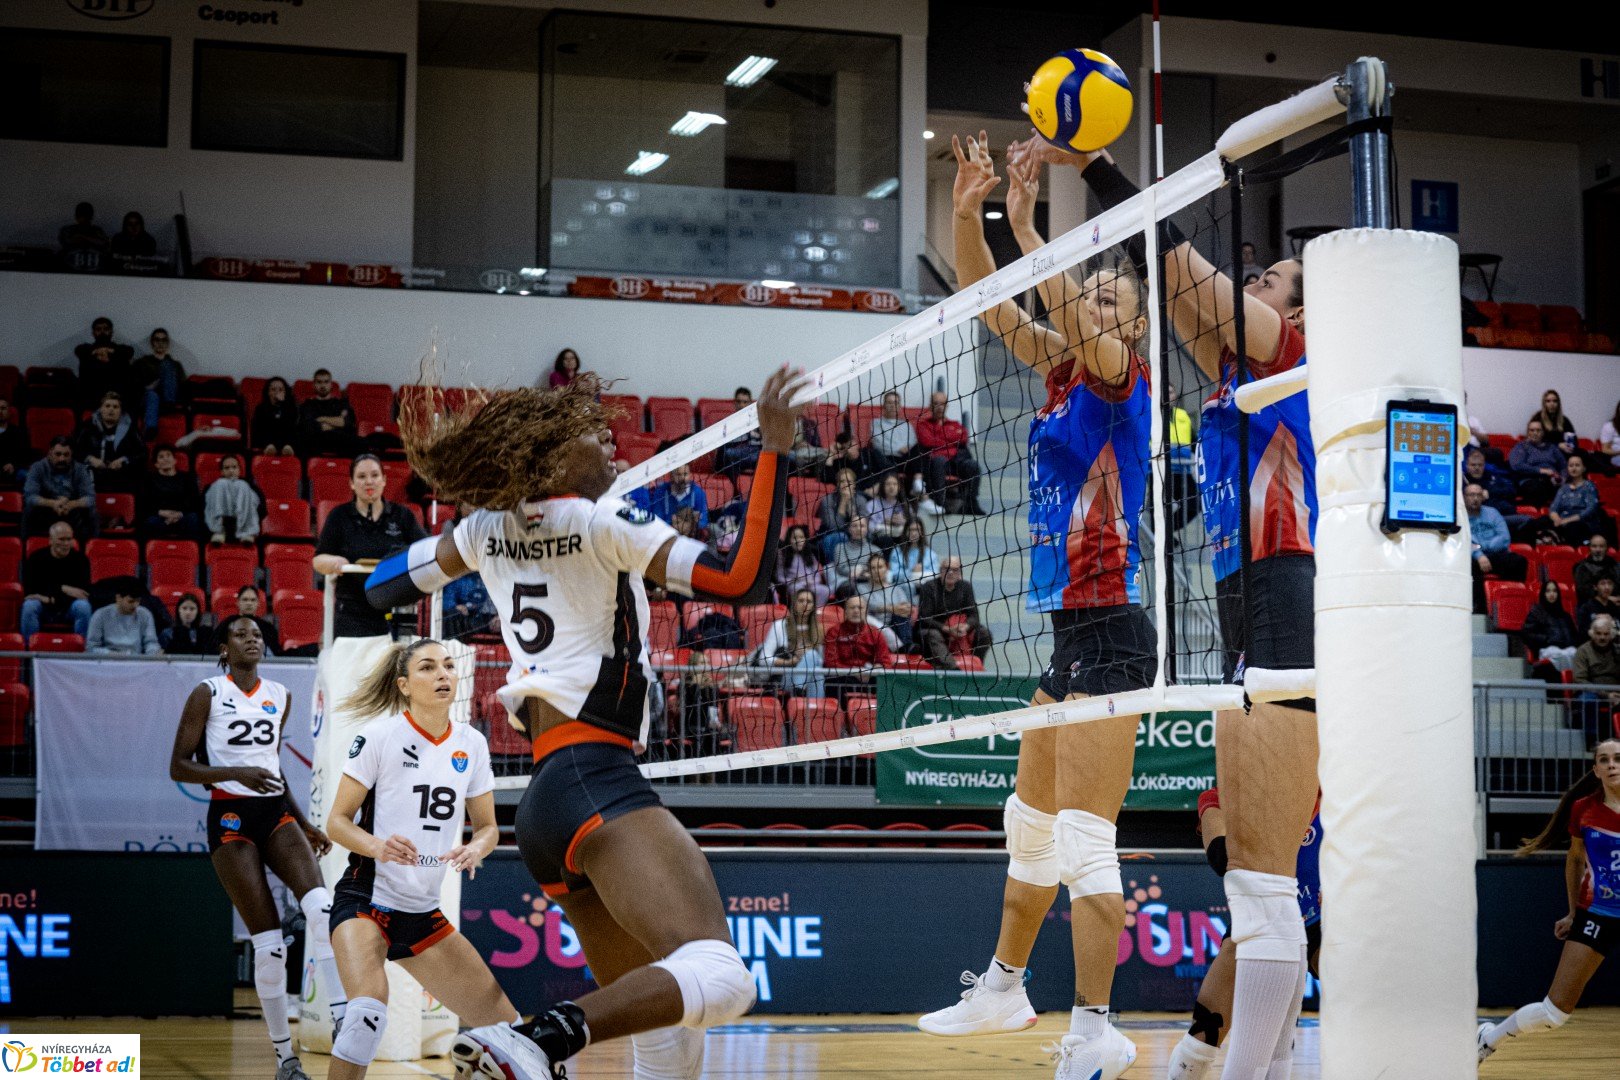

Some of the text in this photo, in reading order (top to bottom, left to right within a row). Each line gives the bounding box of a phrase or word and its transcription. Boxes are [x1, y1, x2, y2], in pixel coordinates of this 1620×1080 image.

[199, 5, 279, 25] Csoport
[217, 260, 244, 275] BH
[353, 266, 380, 281] BH
[616, 280, 642, 295] BH
[745, 286, 770, 301] BH
[870, 293, 896, 309] BH
[1398, 472, 1445, 484] 6 3
[486, 533, 583, 560] BANNSTER
[511, 582, 555, 654] 5
[228, 719, 275, 746] 23
[402, 761, 420, 769] nine
[905, 767, 1007, 788] NYÍREGYHÁZA
[412, 784, 457, 821] 18
[728, 892, 790, 912] zene!
[726, 916, 822, 957] INE
[1583, 920, 1601, 939] 21
